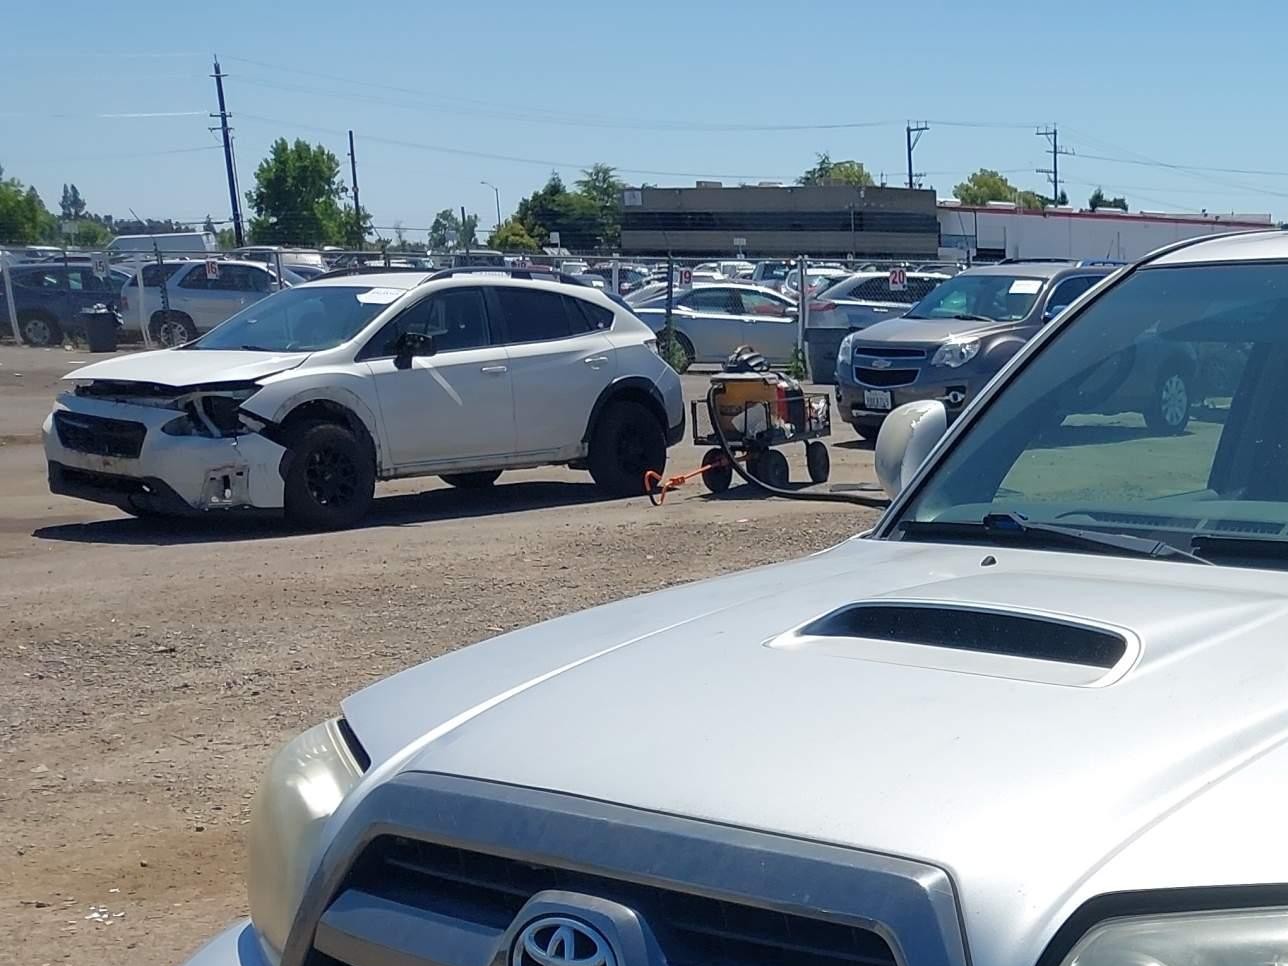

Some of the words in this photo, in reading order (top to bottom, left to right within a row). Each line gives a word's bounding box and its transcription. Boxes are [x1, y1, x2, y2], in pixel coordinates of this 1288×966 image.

[206, 260, 218, 274] 16
[679, 270, 693, 284] 19
[890, 269, 906, 285] 20
